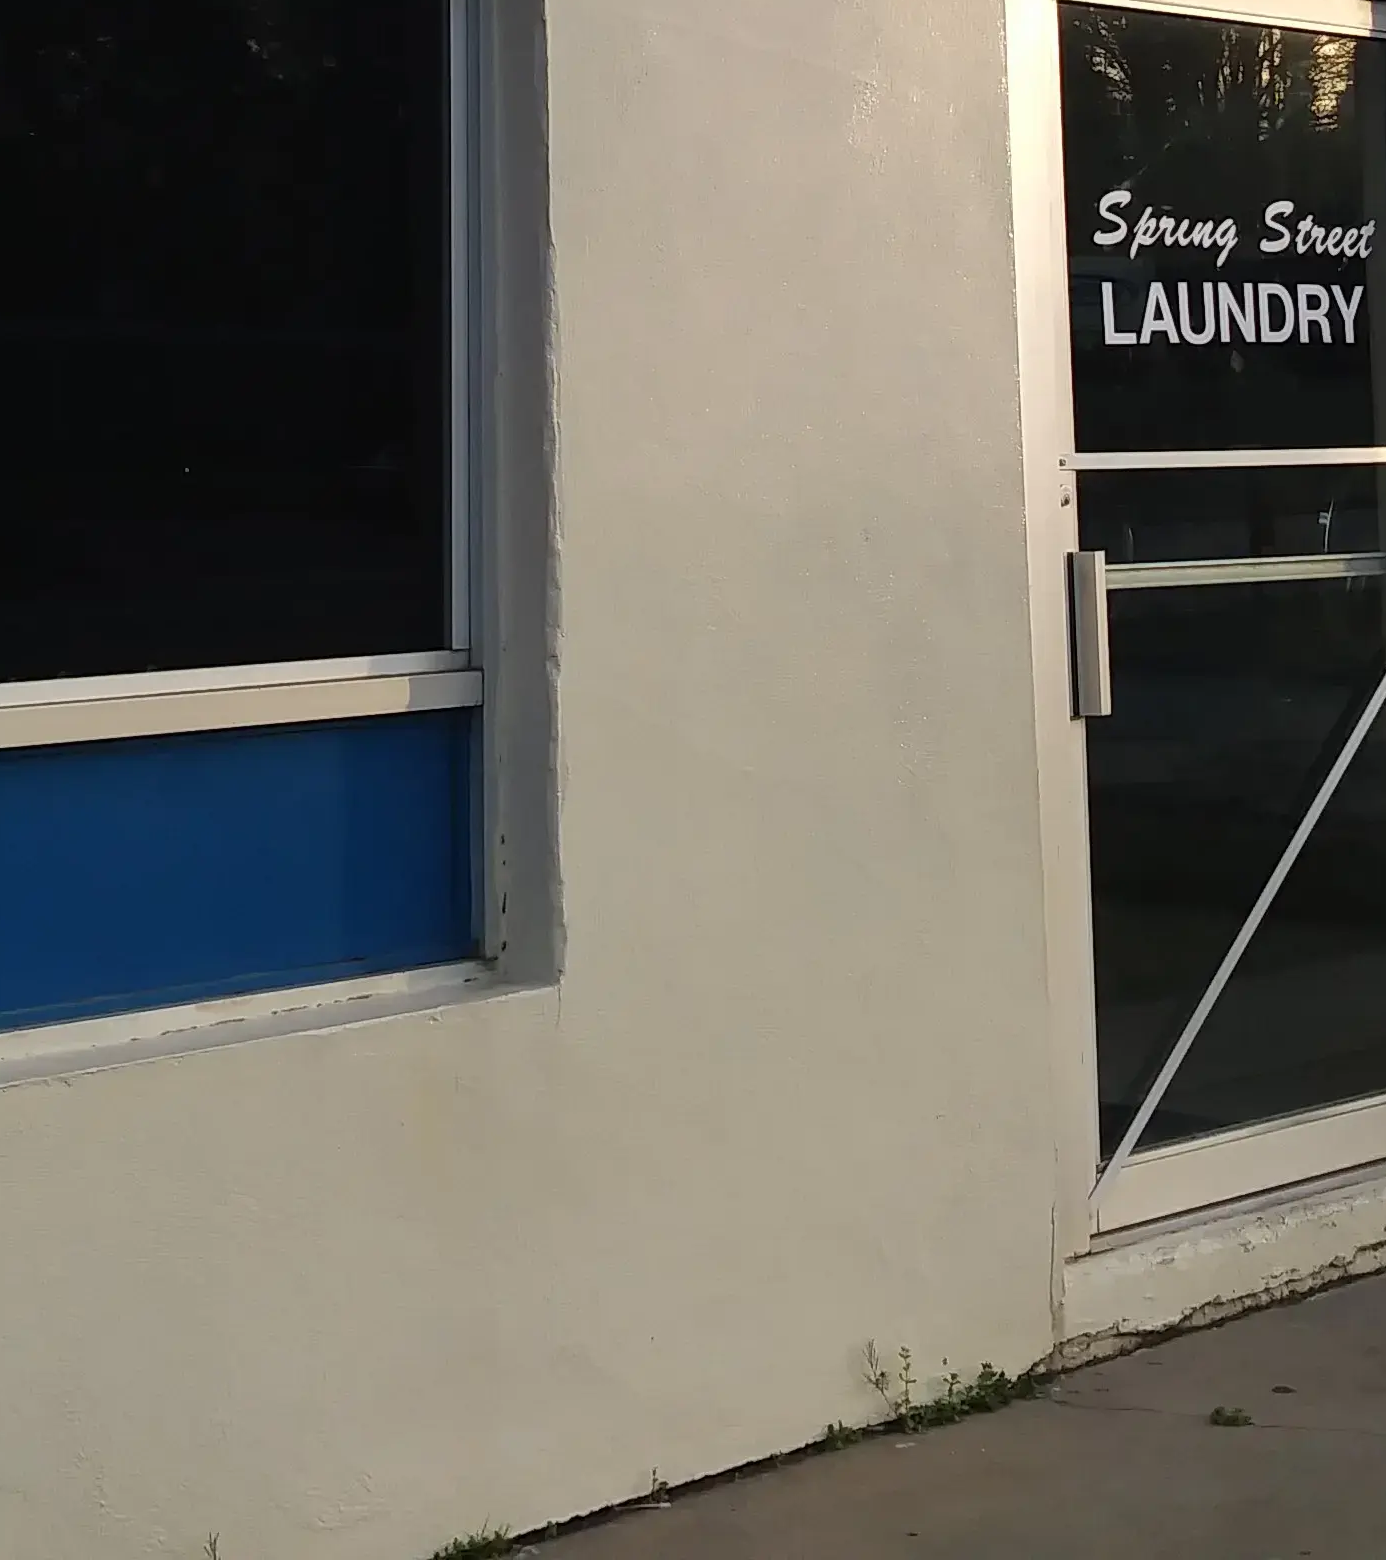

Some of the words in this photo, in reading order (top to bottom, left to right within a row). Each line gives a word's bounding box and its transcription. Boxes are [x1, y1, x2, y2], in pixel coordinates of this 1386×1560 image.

[1093, 189, 1239, 268] Spring
[1259, 199, 1376, 259] Street
[1101, 281, 1364, 345] LAUNDRY
